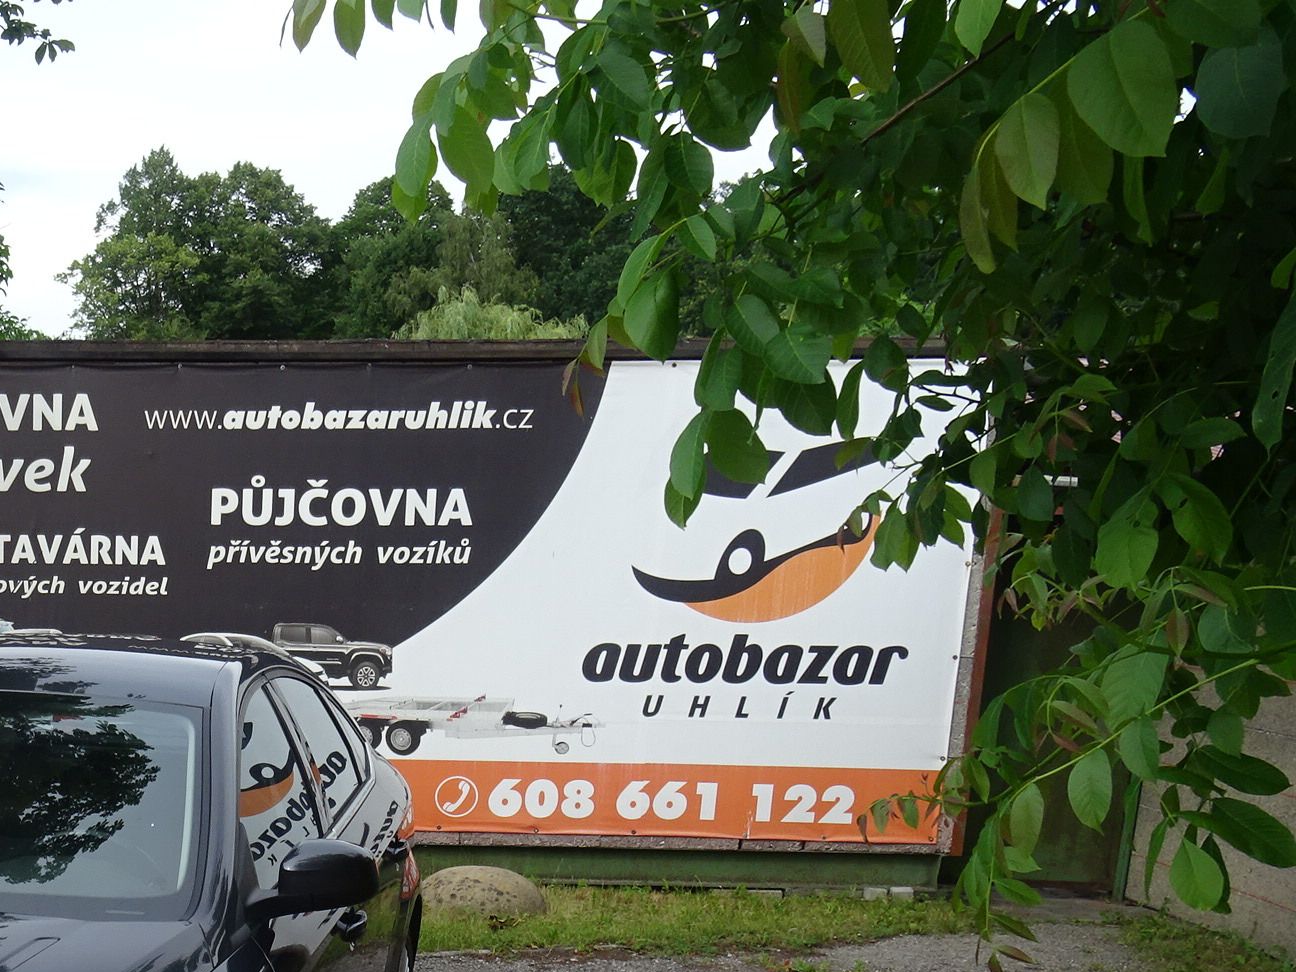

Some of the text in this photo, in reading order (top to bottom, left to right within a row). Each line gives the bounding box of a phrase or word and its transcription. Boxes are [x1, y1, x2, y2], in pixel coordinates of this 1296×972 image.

[144, 401, 534, 430] www.autobazaruhlik.cz
[210, 475, 473, 526] PŮJČOVNA
[206, 538, 472, 570] přívěsných vozíků
[78, 577, 168, 595] vozidel
[581, 633, 909, 686] autobazar
[642, 691, 838, 720] UHLÍK
[487, 778, 856, 824] 608 661 122
